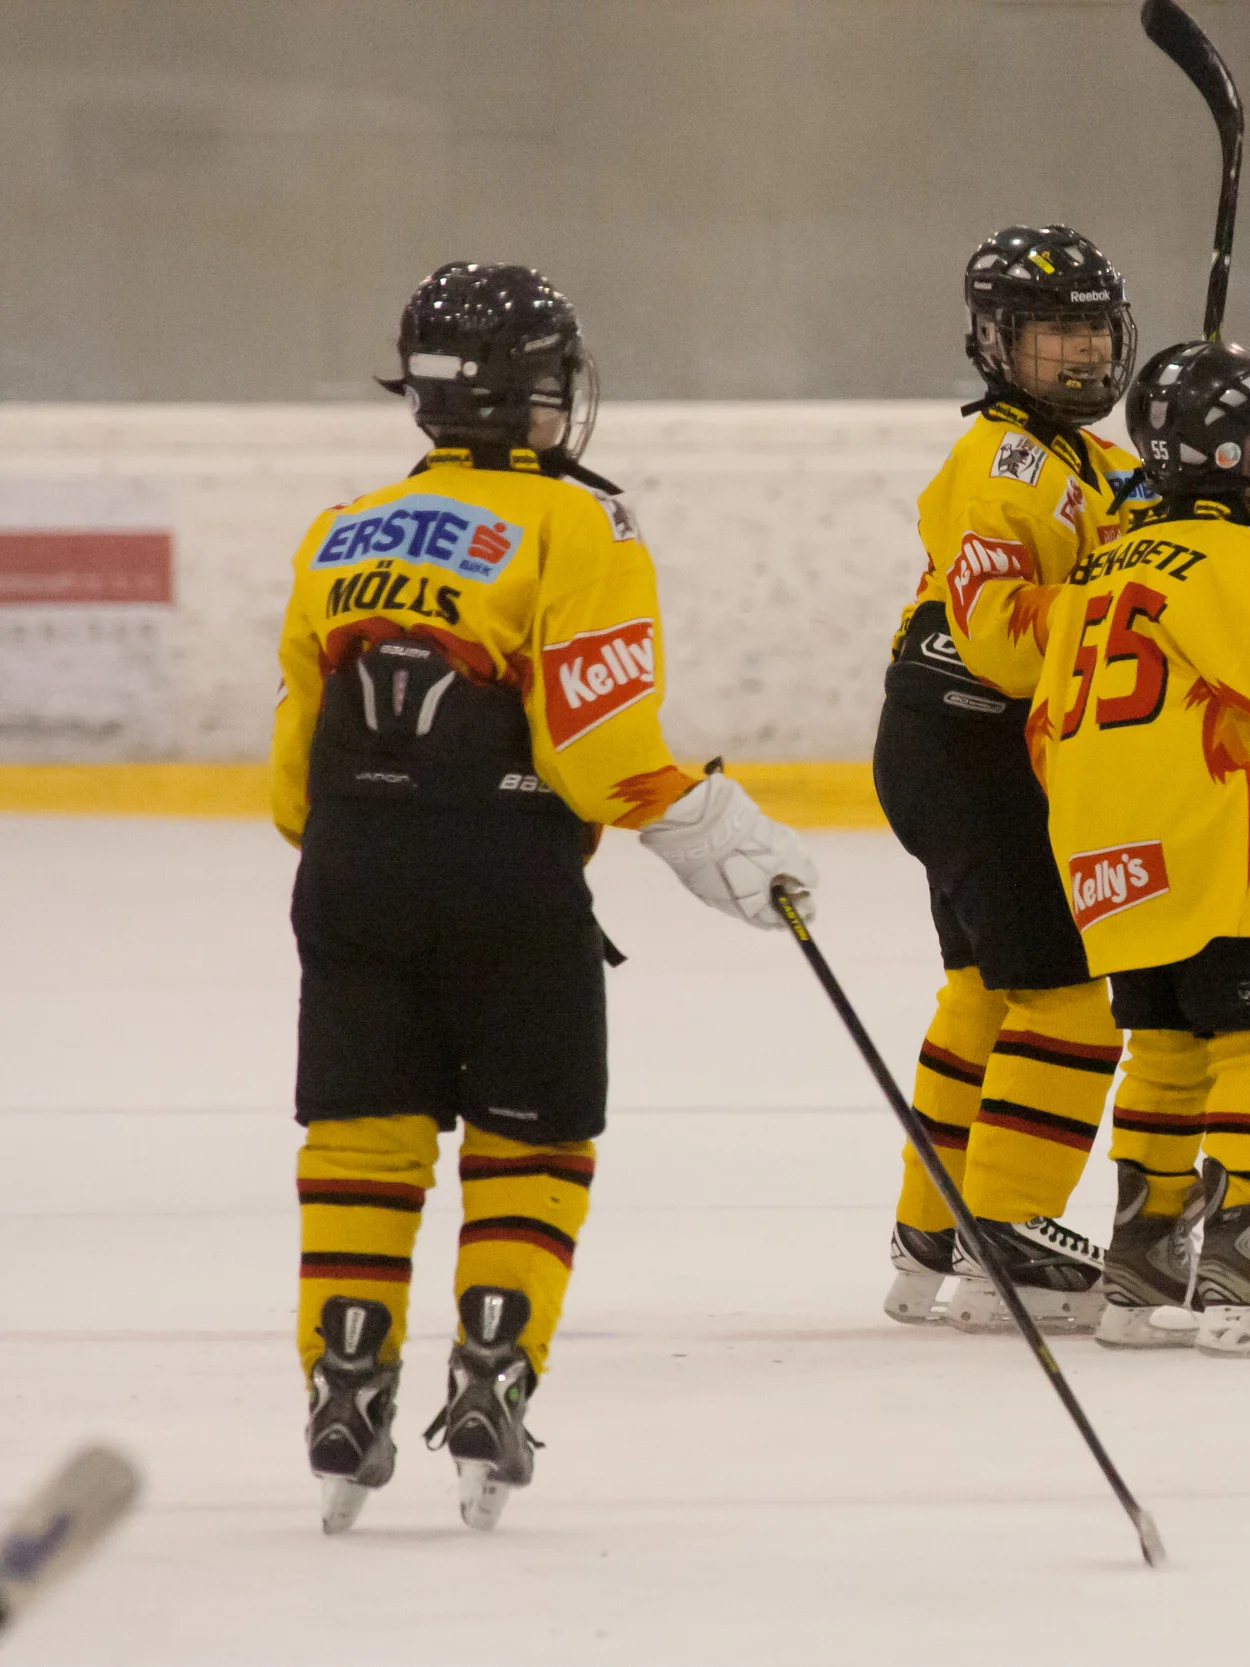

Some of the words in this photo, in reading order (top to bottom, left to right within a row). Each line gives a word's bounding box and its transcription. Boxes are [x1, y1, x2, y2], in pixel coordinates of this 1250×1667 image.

[1070, 289, 1111, 303] Reebok
[1151, 440, 1169, 460] 55
[316, 508, 471, 563] ERSTE
[325, 560, 462, 626] MÖLLS
[1060, 580, 1169, 740] 55
[1071, 852, 1150, 915] Kelly's
